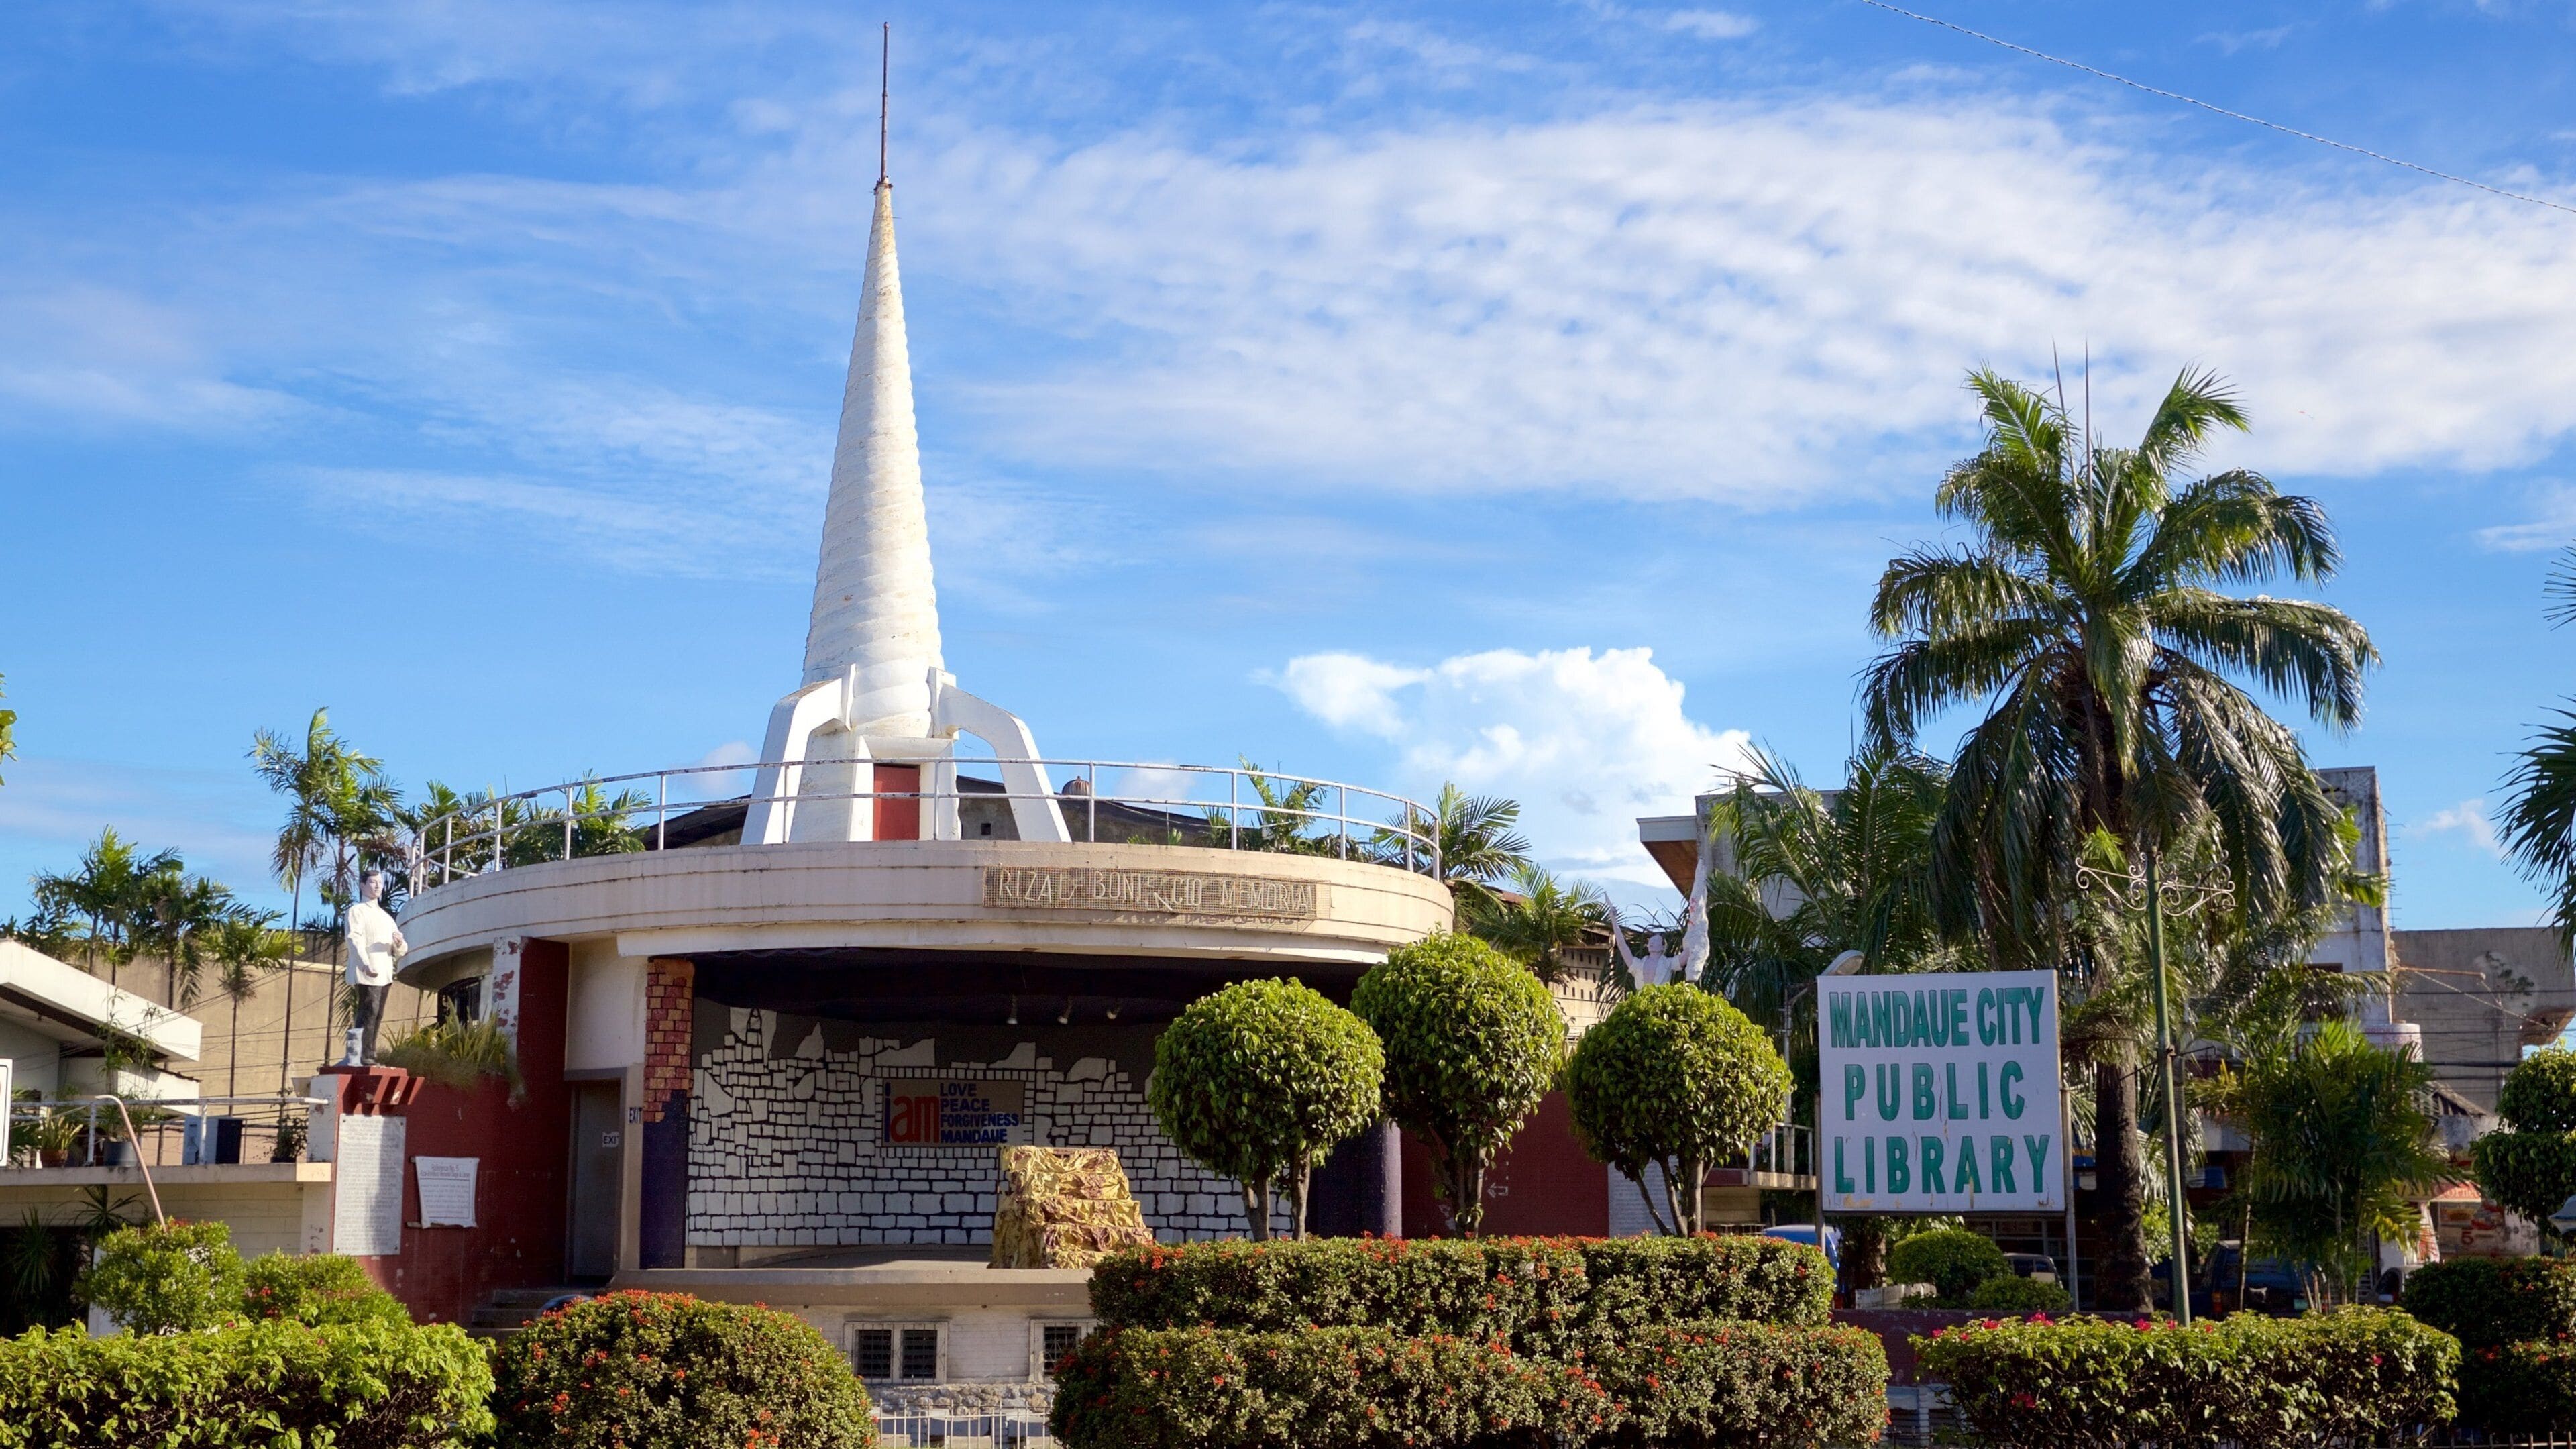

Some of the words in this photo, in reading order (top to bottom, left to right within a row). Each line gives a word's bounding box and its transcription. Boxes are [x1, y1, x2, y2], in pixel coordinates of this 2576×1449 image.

[998, 869, 1073, 904] RIZAL
[1221, 877, 1316, 911] MEMORIAL
[1829, 989, 1970, 1048] MANDAUE
[1976, 987, 2045, 1046] CITY
[940, 1083, 977, 1097] LOVE
[1844, 1061, 2025, 1121] PUBLIC
[940, 1098, 990, 1112] PEACE
[940, 1113, 1020, 1128] FORGIVENESS
[940, 1128, 1008, 1143] MANDAUE
[1834, 1134, 2051, 1194] LIBRARY
